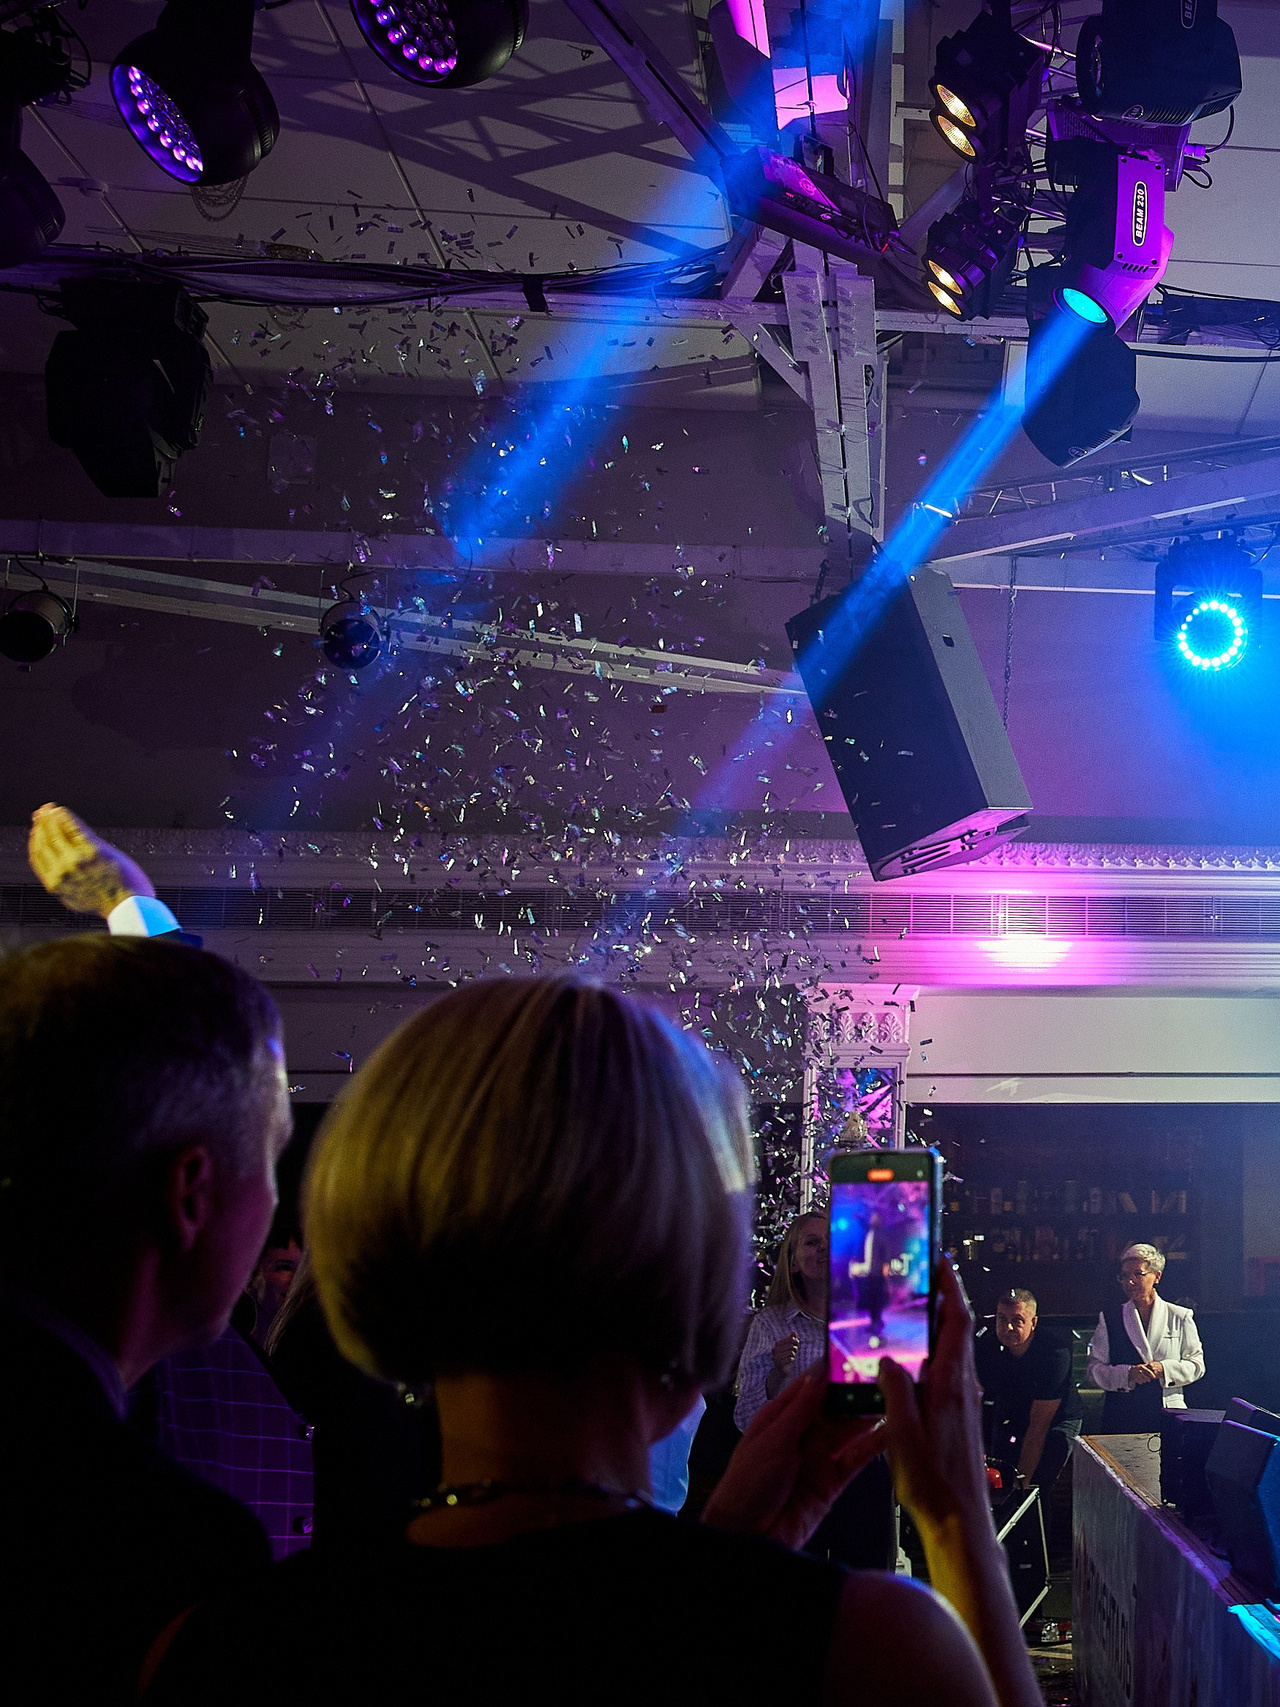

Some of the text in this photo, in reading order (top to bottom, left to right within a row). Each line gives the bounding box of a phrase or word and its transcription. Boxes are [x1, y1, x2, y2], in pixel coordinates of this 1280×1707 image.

[1184, 0, 1194, 19] BE
[1135, 188, 1145, 238] BEAM 230
